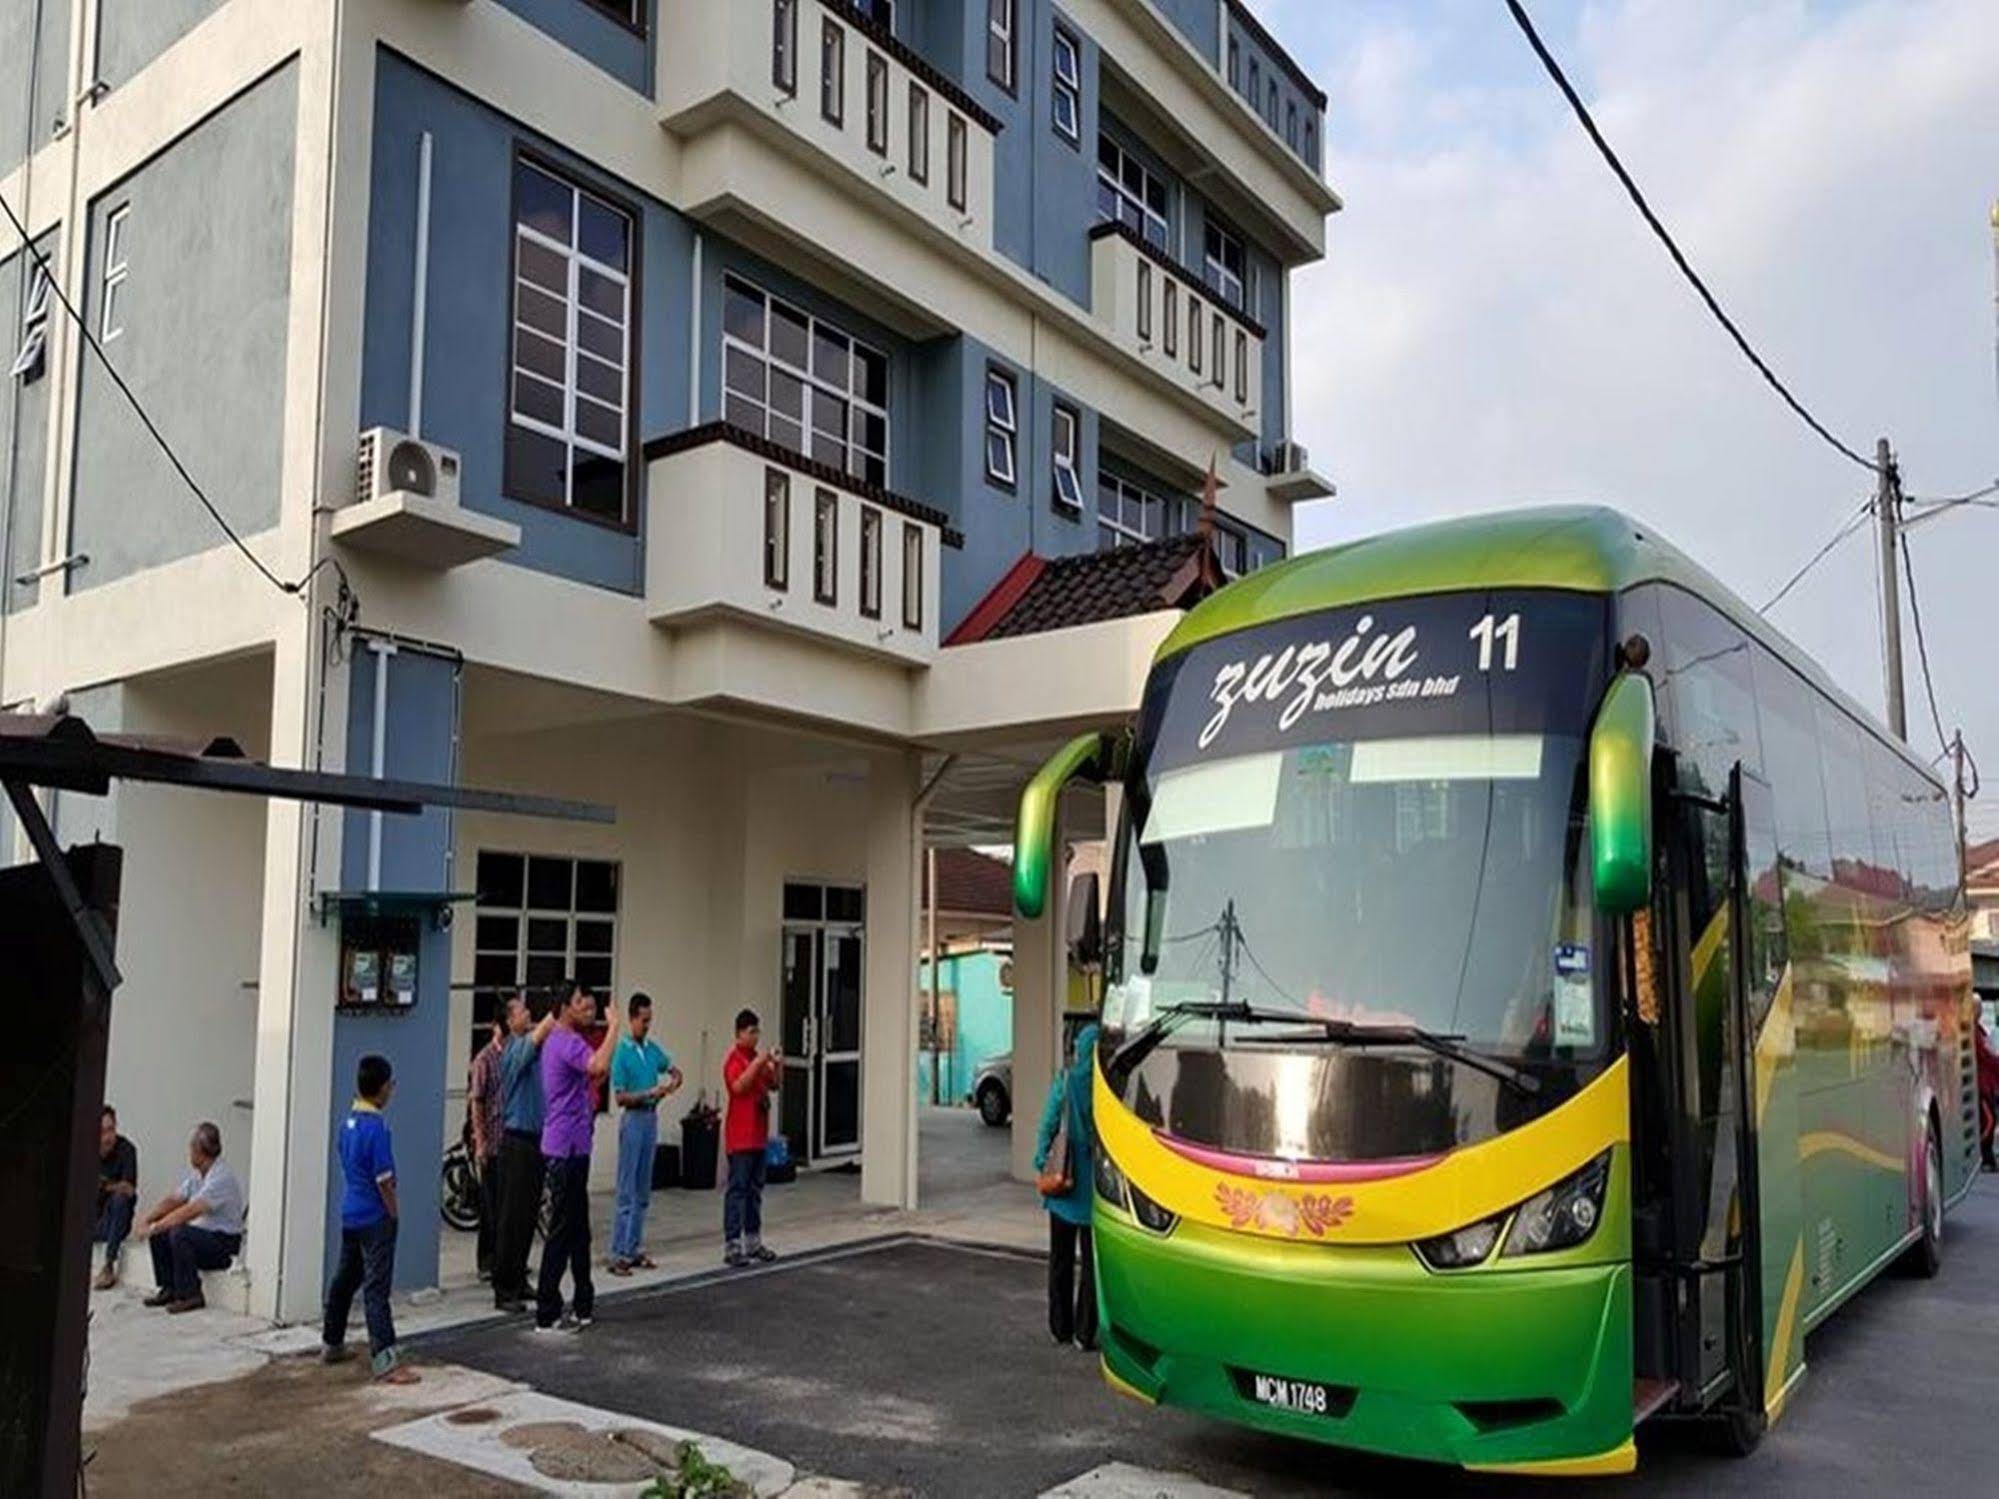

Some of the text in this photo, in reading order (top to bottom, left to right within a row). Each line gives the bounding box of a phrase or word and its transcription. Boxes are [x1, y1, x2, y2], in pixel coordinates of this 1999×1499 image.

[1470, 613, 1519, 670] 11
[1199, 616, 1418, 747] zuzin
[1313, 676, 1459, 711] holidays sdn bhd
